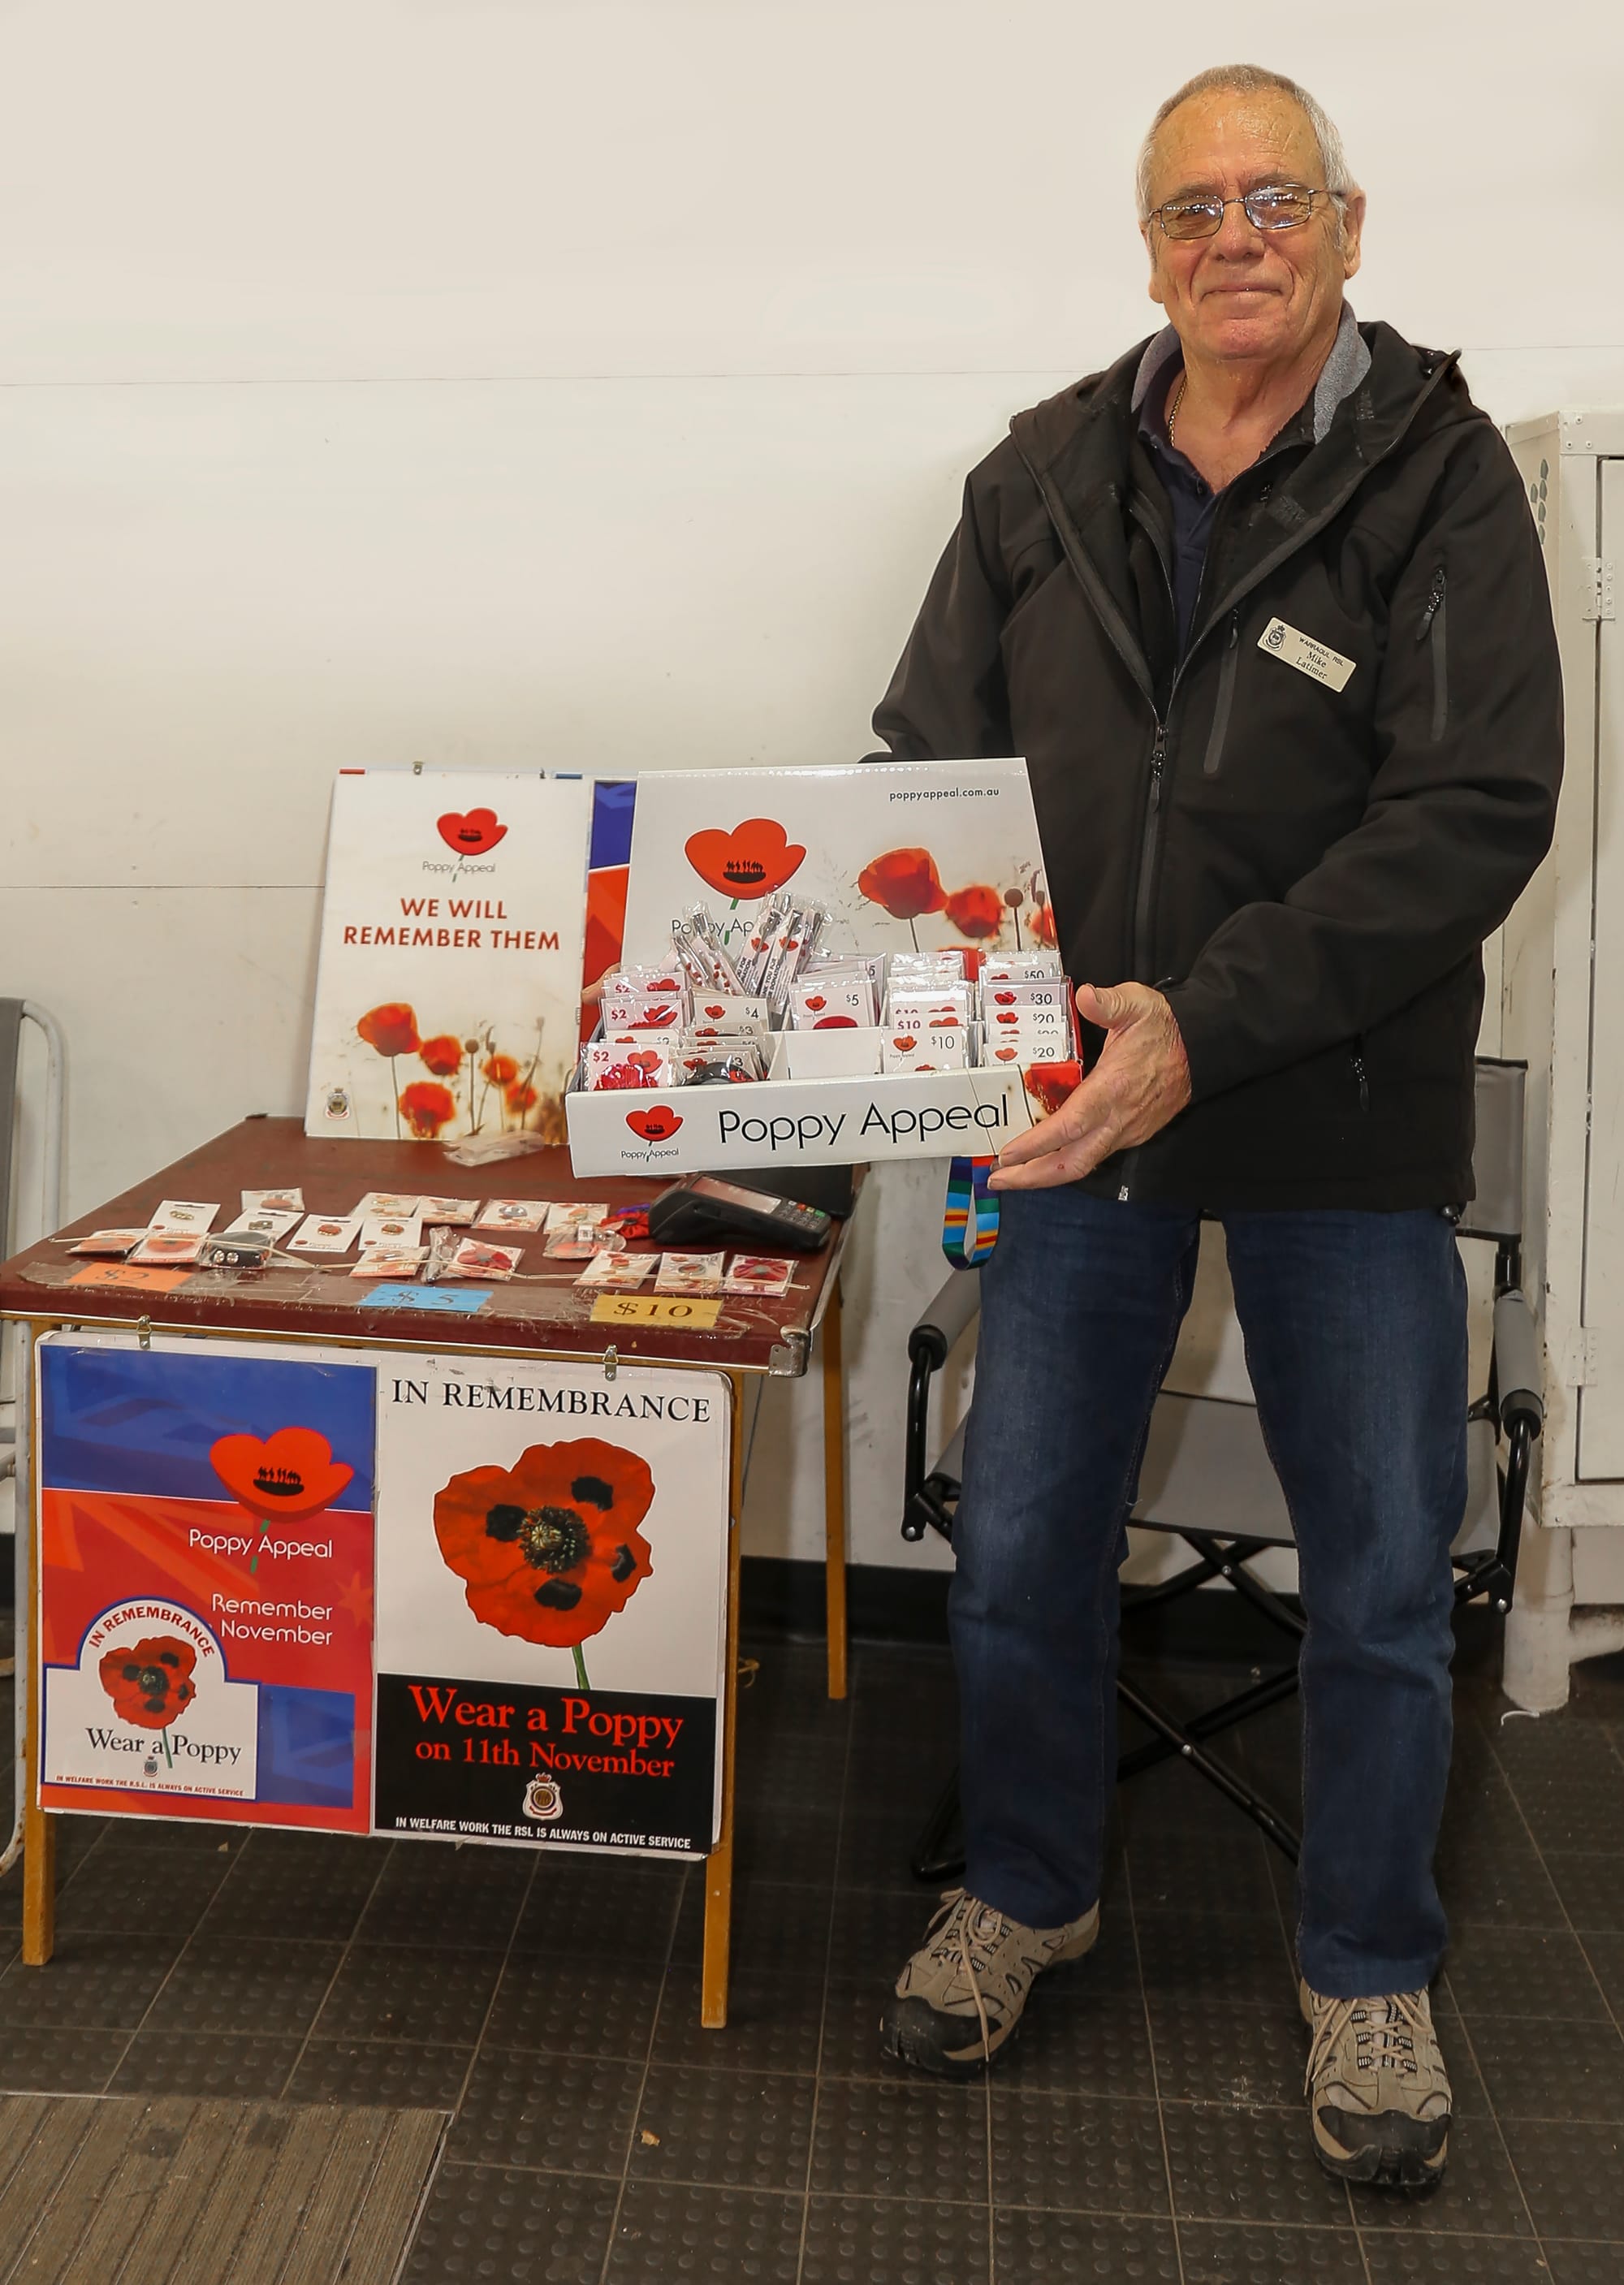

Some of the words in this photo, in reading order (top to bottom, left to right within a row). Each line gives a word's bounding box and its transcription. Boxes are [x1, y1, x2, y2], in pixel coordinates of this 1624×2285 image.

[1307, 651, 1327, 668] Mike
[1332, 656, 1344, 667] RSL
[1296, 657, 1328, 680] Latimer
[889, 787, 1000, 801] poppyappeal.com.au
[422, 861, 454, 874] Poppy
[457, 862, 496, 874] Appeal
[400, 897, 439, 917] WE
[448, 899, 508, 919] WILL
[343, 926, 482, 948] REMEMBER
[490, 930, 560, 951] THEM
[1024, 970, 1044, 979] $50
[846, 993, 859, 1006] $5
[1030, 992, 1052, 1005] $30
[611, 1008, 627, 1021] $2
[745, 1007, 759, 1019] $4
[1033, 1013, 1054, 1023] $20
[897, 1020, 921, 1030] $10
[931, 1035, 955, 1049] $10
[593, 1050, 609, 1063] $2
[1033, 1047, 1055, 1058] $20
[719, 1110, 847, 1151] Poppy
[860, 1094, 1009, 1143] Appeal
[621, 1150, 646, 1160] Poppy
[649, 1148, 679, 1158] Appeal
[95, 1268, 149, 1281] $2
[613, 1302, 693, 1318] $10
[391, 1379, 428, 1405] IN
[443, 1383, 712, 1423] REMEMBRANCE
[189, 1529, 253, 1555] Poppy
[258, 1535, 333, 1560] Appeal
[212, 1593, 333, 1621] Remember
[89, 1630, 106, 1648] IN
[102, 1606, 215, 1657] REMEMBRANCE
[221, 1619, 333, 1645] November
[408, 1685, 516, 1730] Wear
[527, 1708, 548, 1732] a
[561, 1698, 684, 1749] Poppy
[85, 1727, 145, 1752] Wear
[152, 1742, 164, 1754] a
[171, 1734, 241, 1765] Poppy
[416, 1741, 451, 1762] on
[463, 1738, 520, 1767] 11th
[529, 1742, 675, 1777] November
[65, 1776, 93, 1784] WELFARE
[158, 1782, 182, 1791] ALWAYS
[184, 1785, 193, 1793] ON
[195, 1786, 216, 1795] ACTIVE
[218, 1788, 244, 1797] SERVICE
[395, 1816, 407, 1828] IN
[409, 1817, 456, 1831] WELFARE
[459, 1821, 489, 1834] WORK
[492, 1823, 512, 1836] THE
[514, 1825, 533, 1838] RSL
[536, 1827, 547, 1838] IS
[549, 1828, 590, 1842] ALWAYS
[593, 1831, 607, 1843] ON
[610, 1832, 646, 1846] ACTIVE
[648, 1835, 691, 1849] SERVICE
